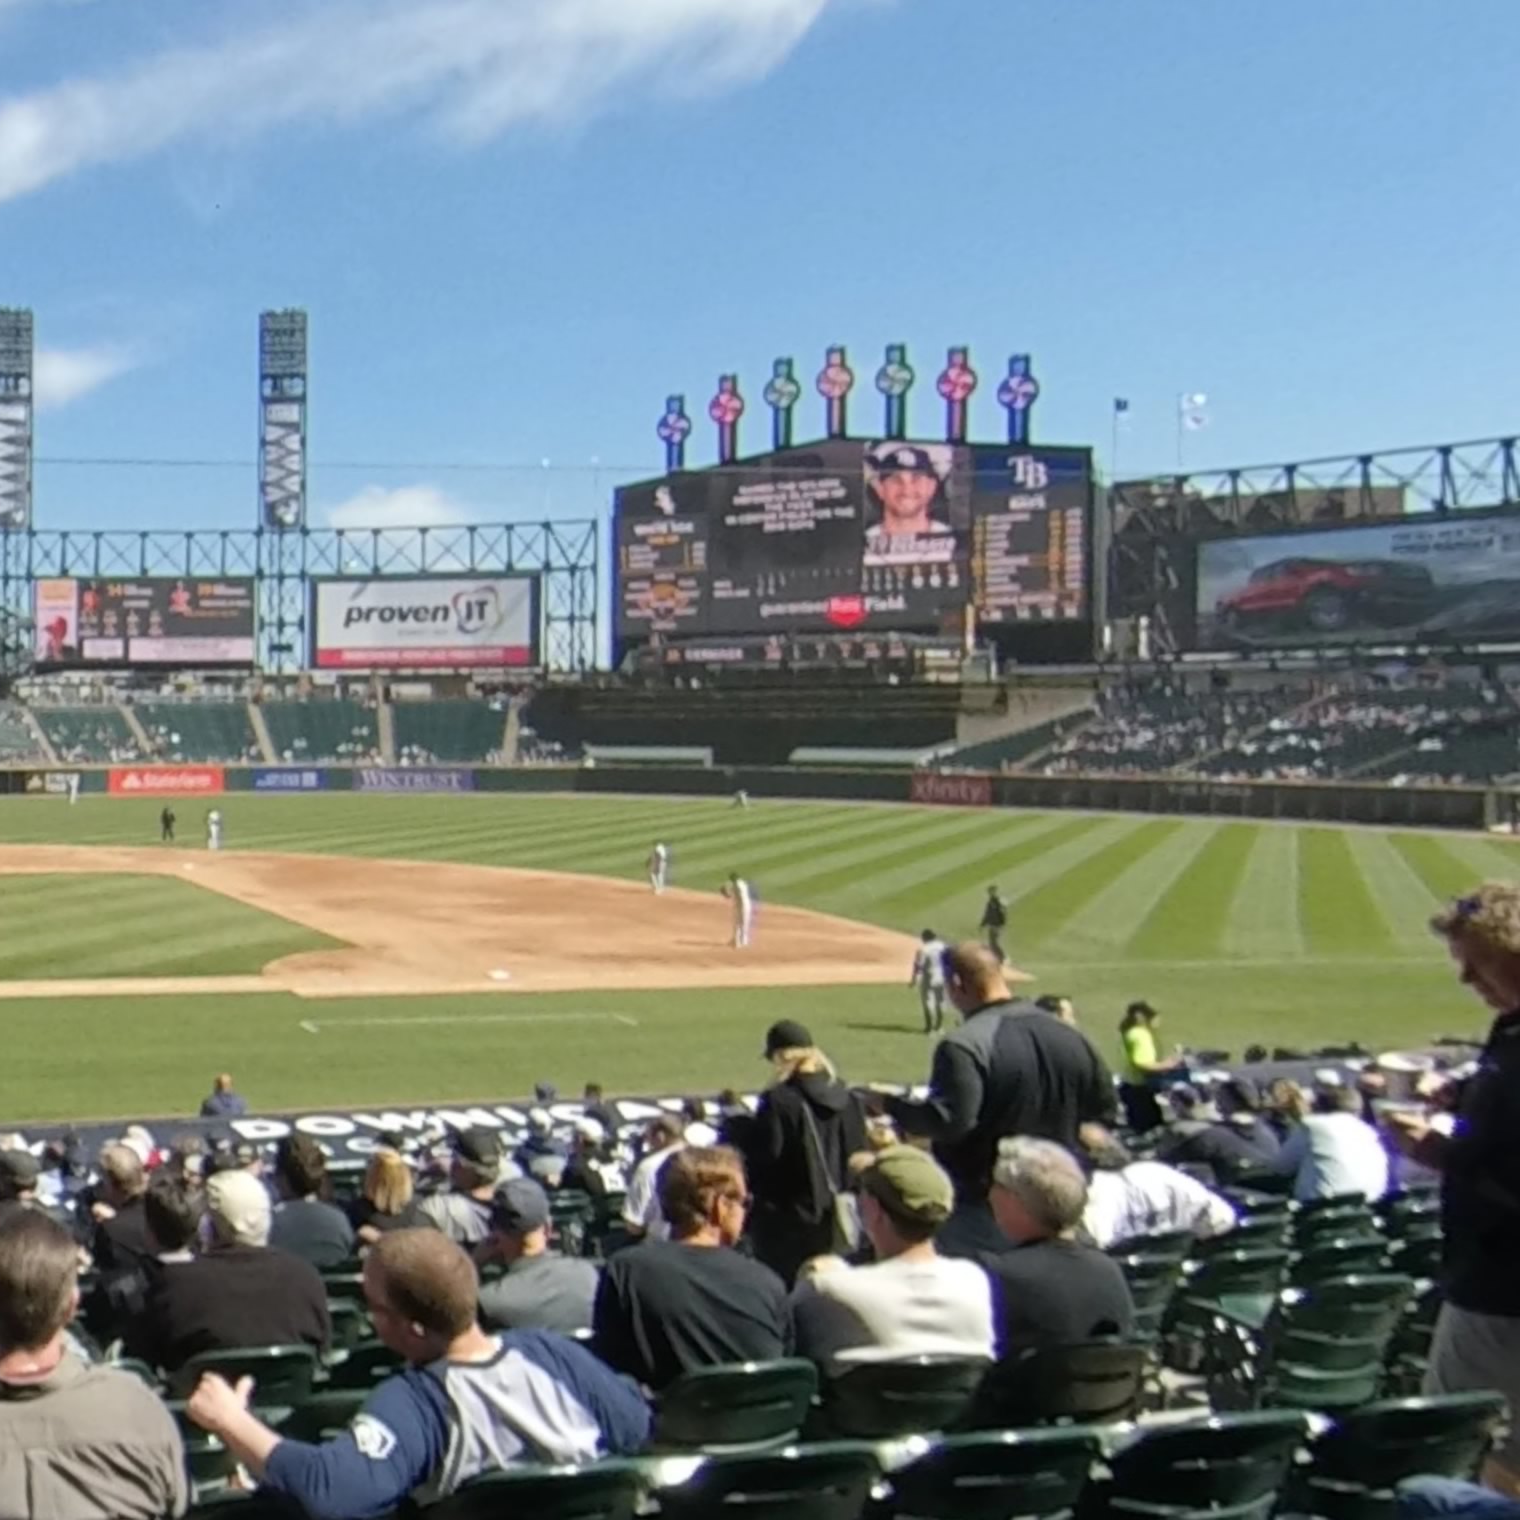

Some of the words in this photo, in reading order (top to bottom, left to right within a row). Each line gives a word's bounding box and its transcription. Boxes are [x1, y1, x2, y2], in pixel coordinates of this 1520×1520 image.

[1008, 456, 1048, 489] TB
[343, 604, 450, 629] proven
[465, 600, 489, 622] IT
[360, 770, 460, 788] WINTRUST
[912, 775, 983, 804] xfinity
